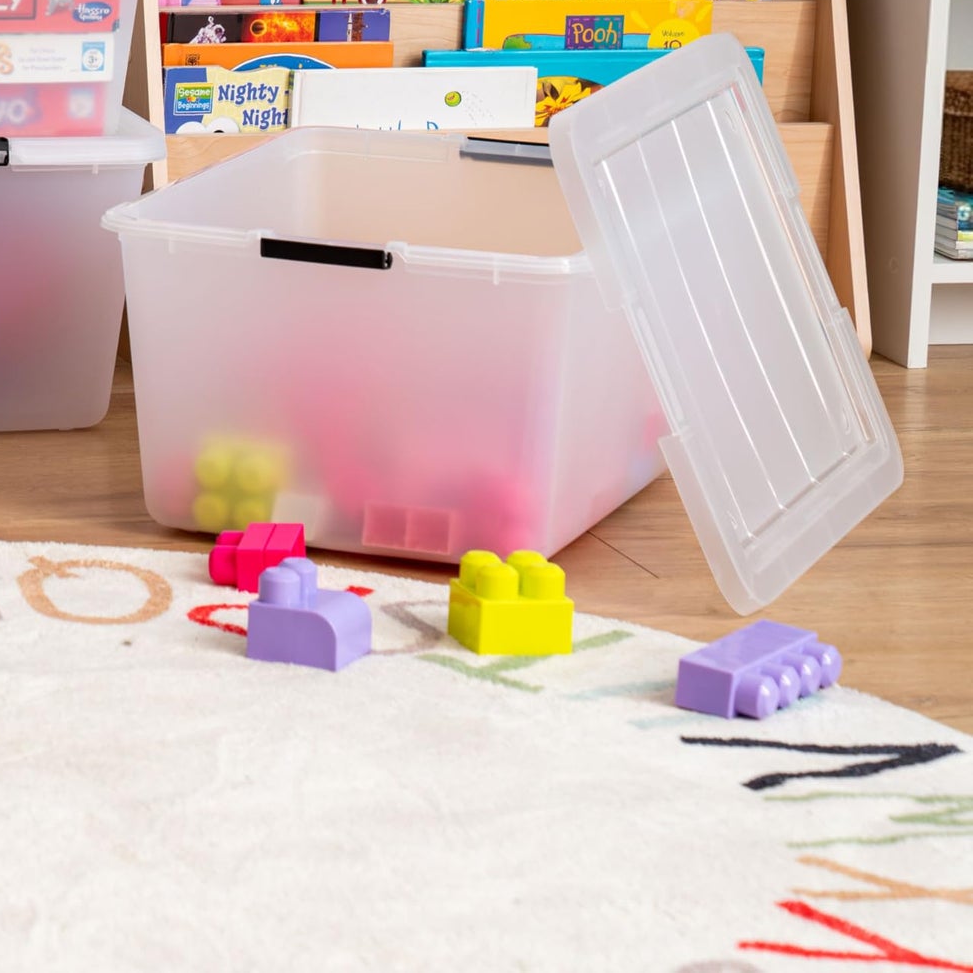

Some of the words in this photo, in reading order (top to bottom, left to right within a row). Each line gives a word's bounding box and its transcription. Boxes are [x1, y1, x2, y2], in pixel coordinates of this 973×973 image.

[571, 21, 618, 45] Pooh
[178, 87, 211, 97] Sesame
[242, 107, 289, 132] Night
